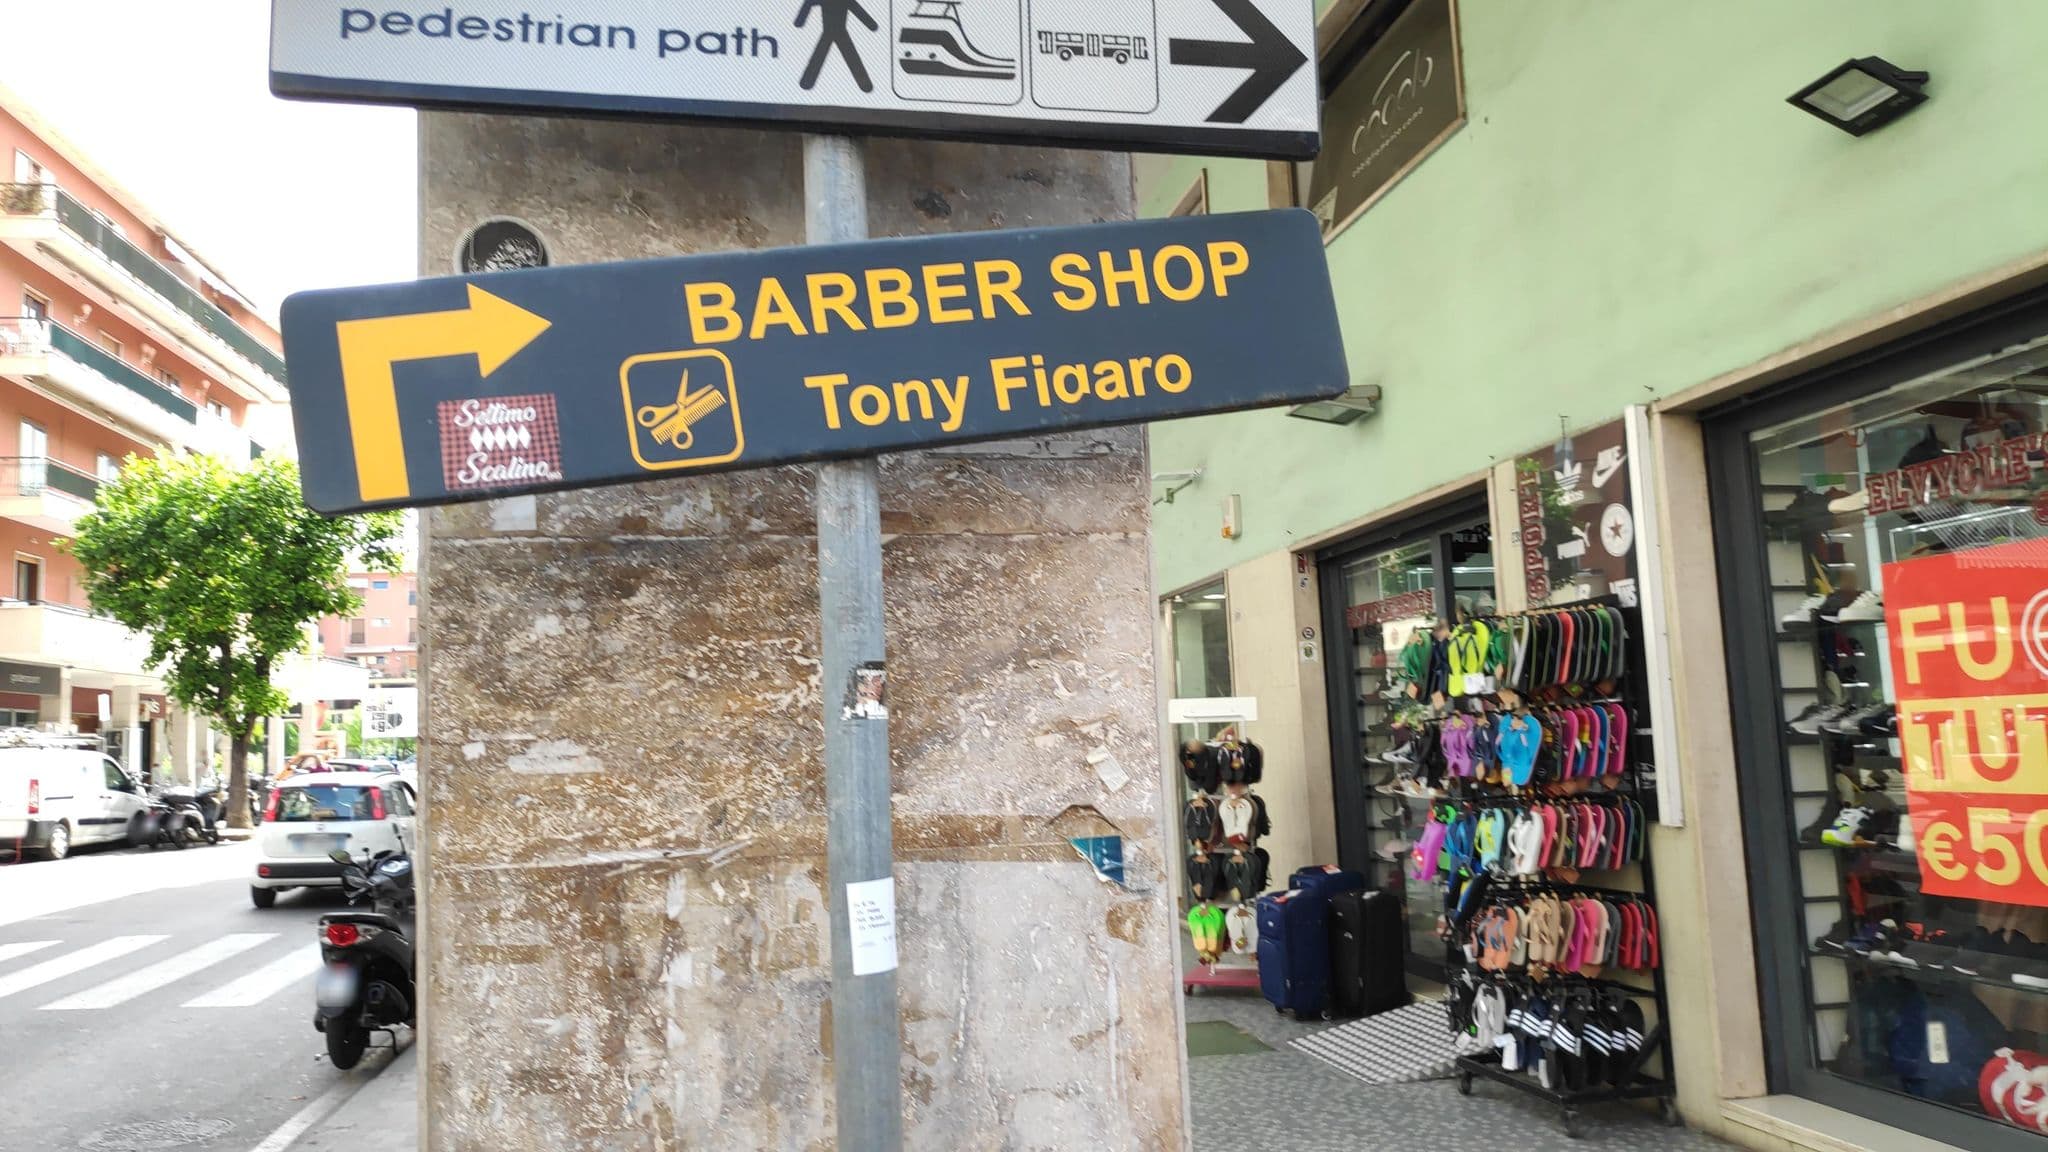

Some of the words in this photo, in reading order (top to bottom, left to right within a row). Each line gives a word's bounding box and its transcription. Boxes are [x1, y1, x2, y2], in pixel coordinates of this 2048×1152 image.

[340, 6, 636, 51] pedestrian
[658, 26, 779, 59] path
[685, 260, 1029, 344] BARBER
[1050, 241, 1249, 311] SHOP
[454, 399, 537, 427] Settimo
[804, 373, 969, 433] Tony
[458, 451, 549, 484] Scalino
